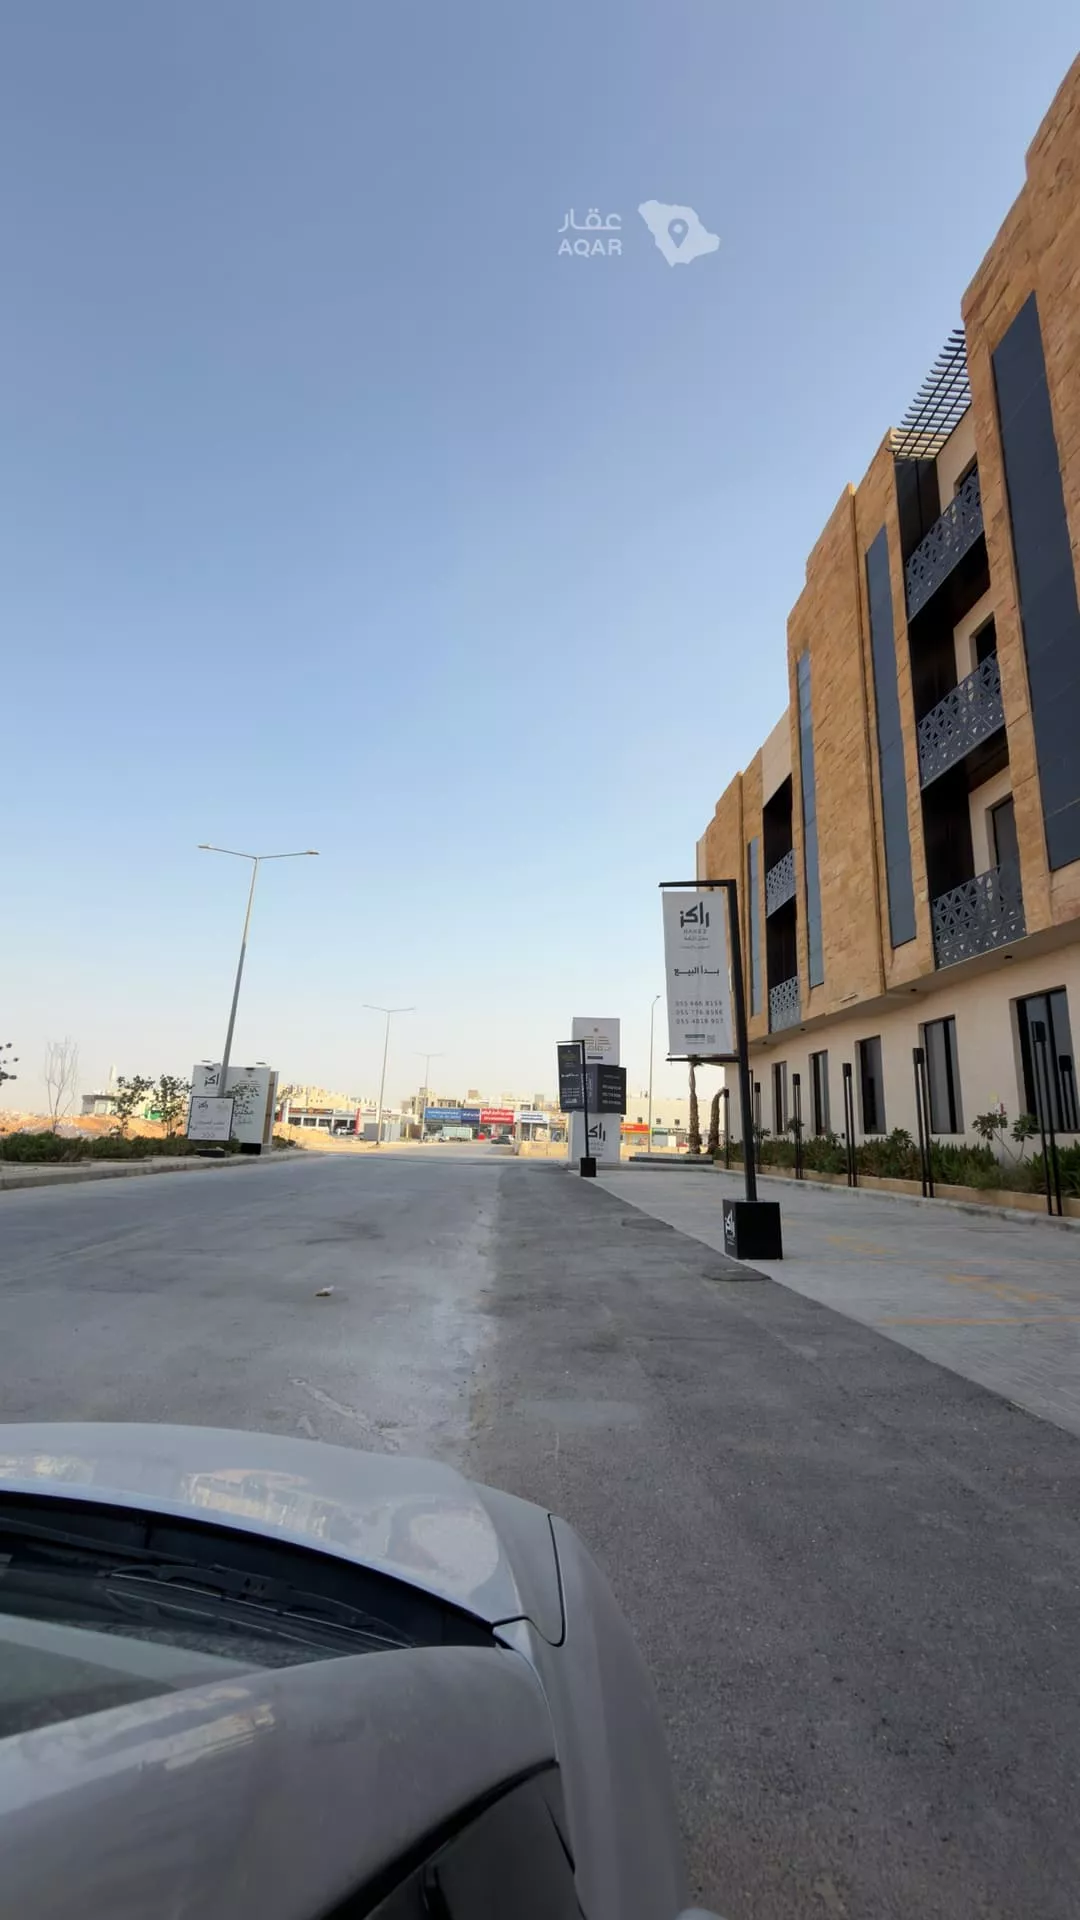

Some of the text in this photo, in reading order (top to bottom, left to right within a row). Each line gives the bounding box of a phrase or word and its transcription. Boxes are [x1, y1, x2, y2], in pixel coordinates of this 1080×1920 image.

[680, 901, 710, 929] راكز
[204, 1073, 219, 1087] اكز
[588, 1122, 606, 1142] راك
